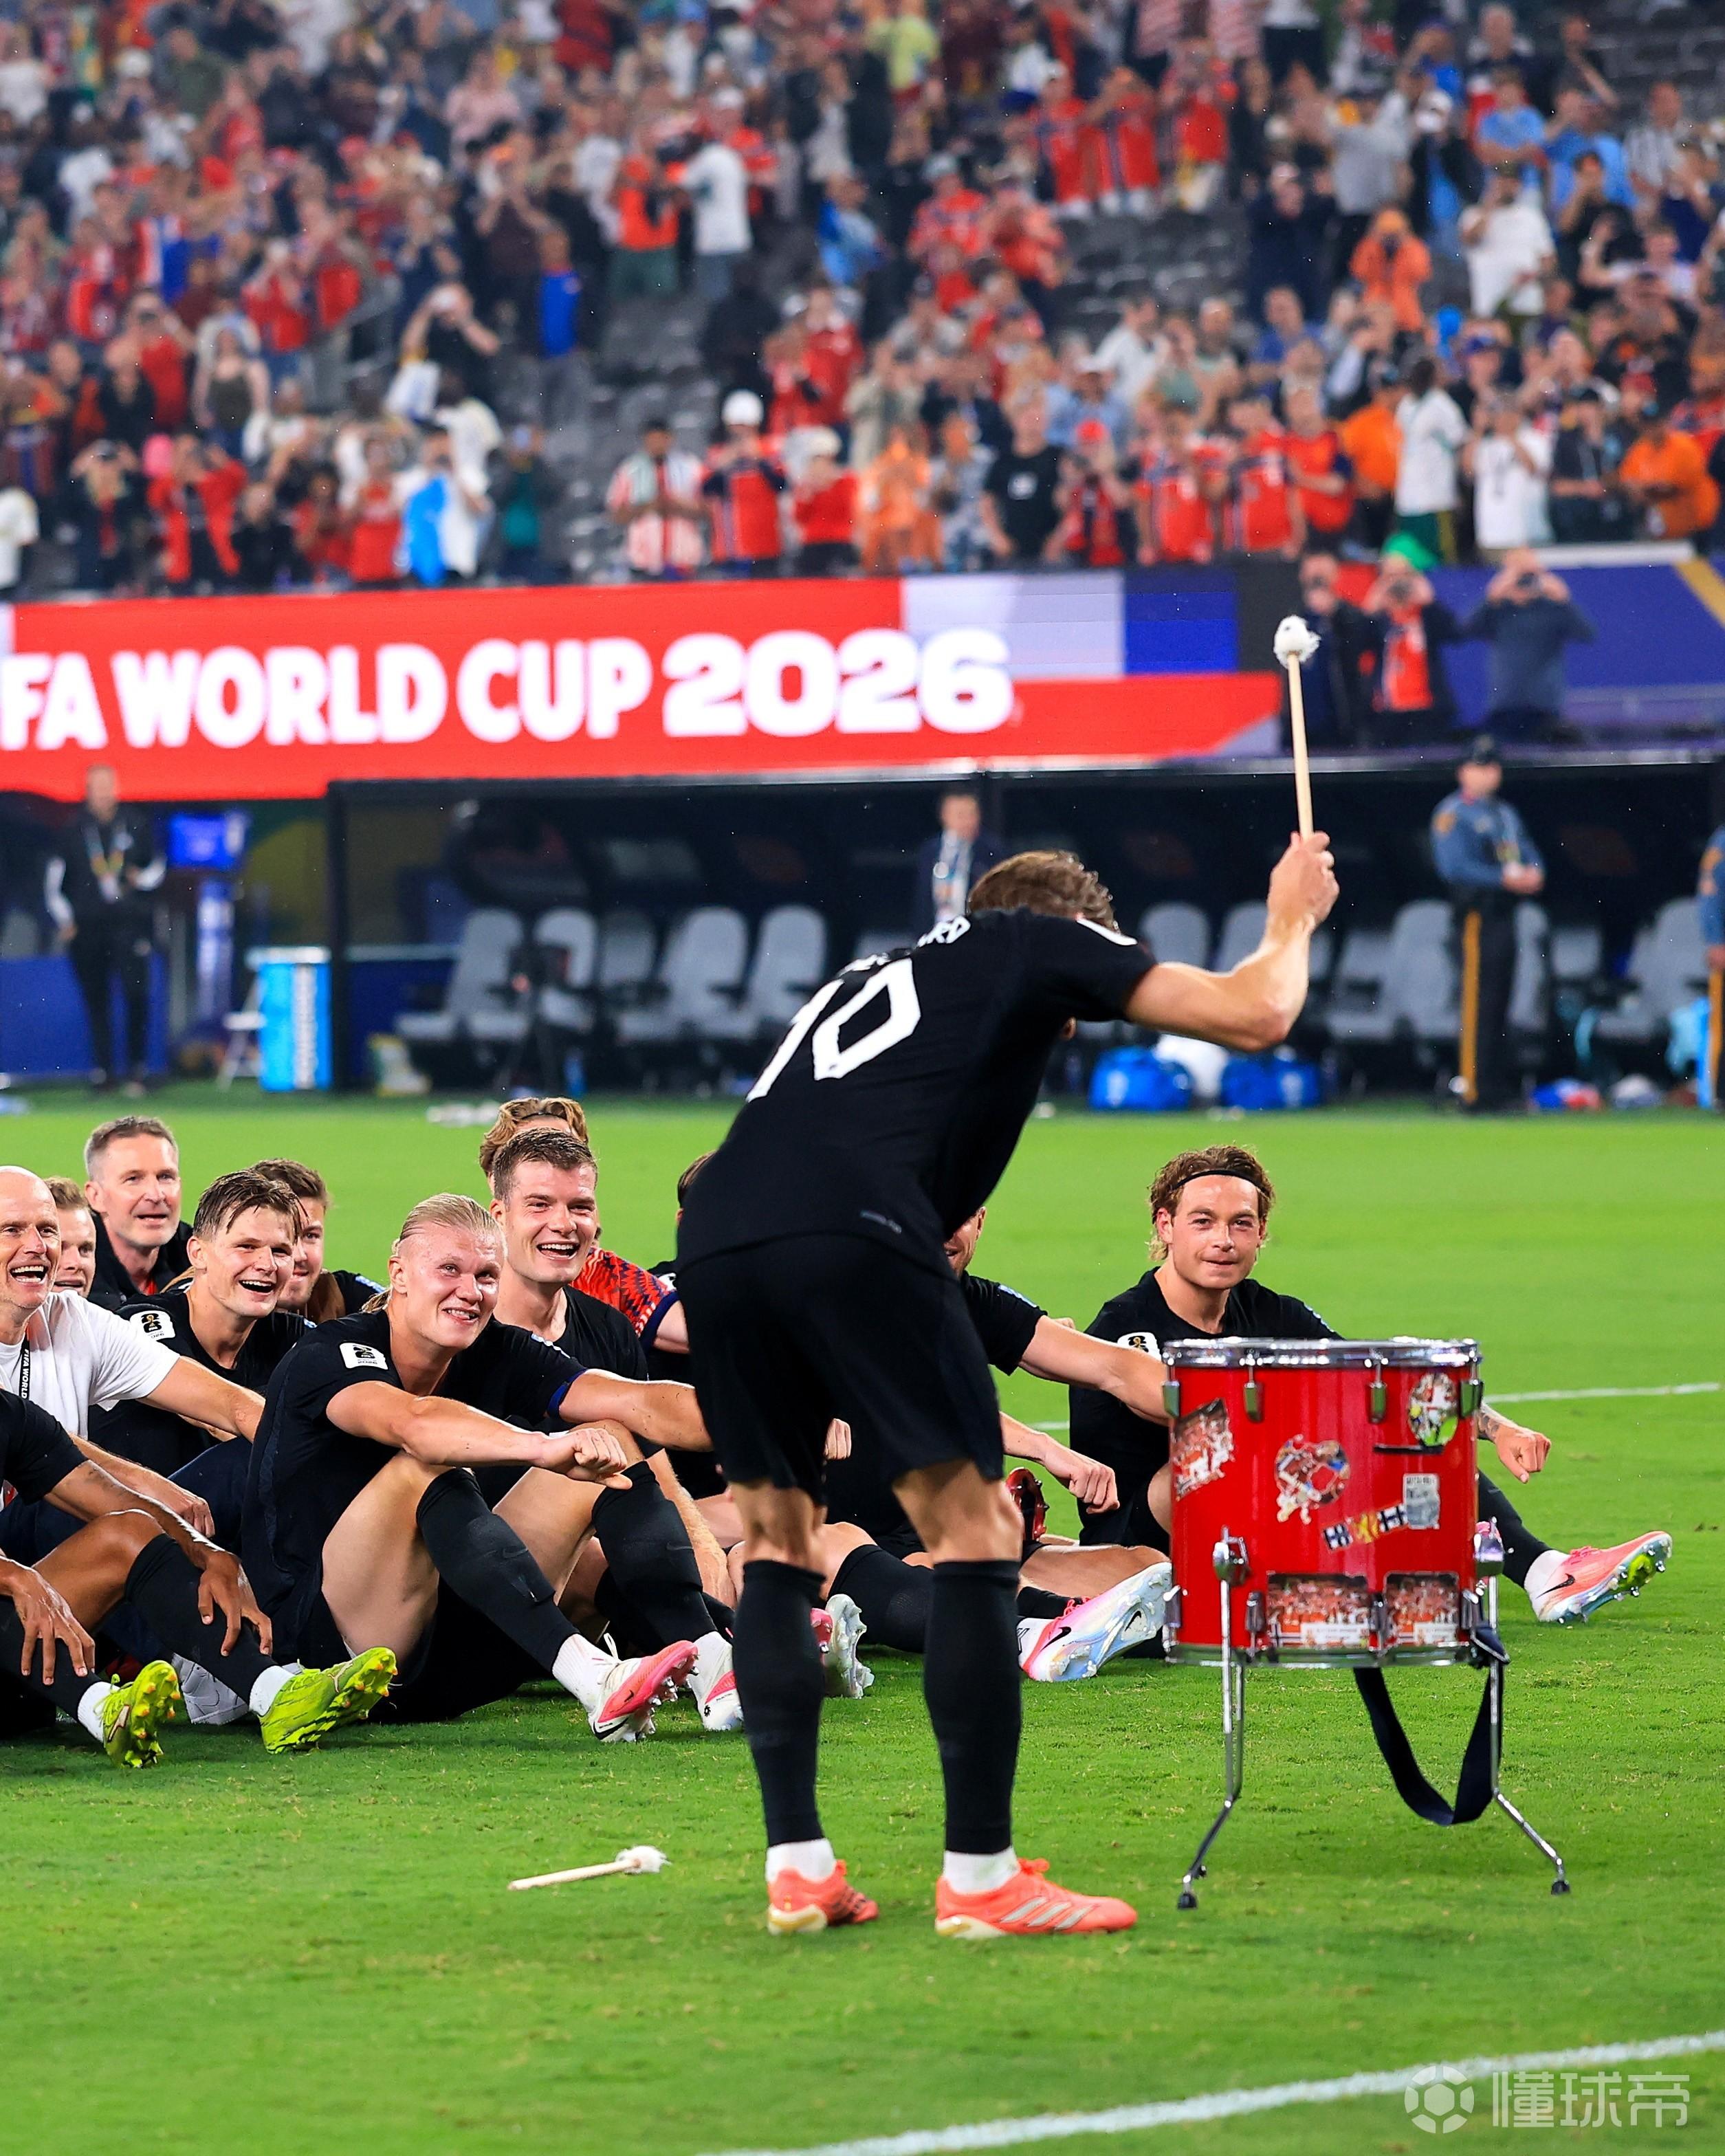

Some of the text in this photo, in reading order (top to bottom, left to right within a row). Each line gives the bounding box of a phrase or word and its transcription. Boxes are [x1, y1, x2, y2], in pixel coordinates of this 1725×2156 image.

[111, 644, 448, 749] WORLD
[457, 637, 654, 743] CUP
[661, 628, 1014, 737] 2026
[745, 957, 921, 1103] 10
